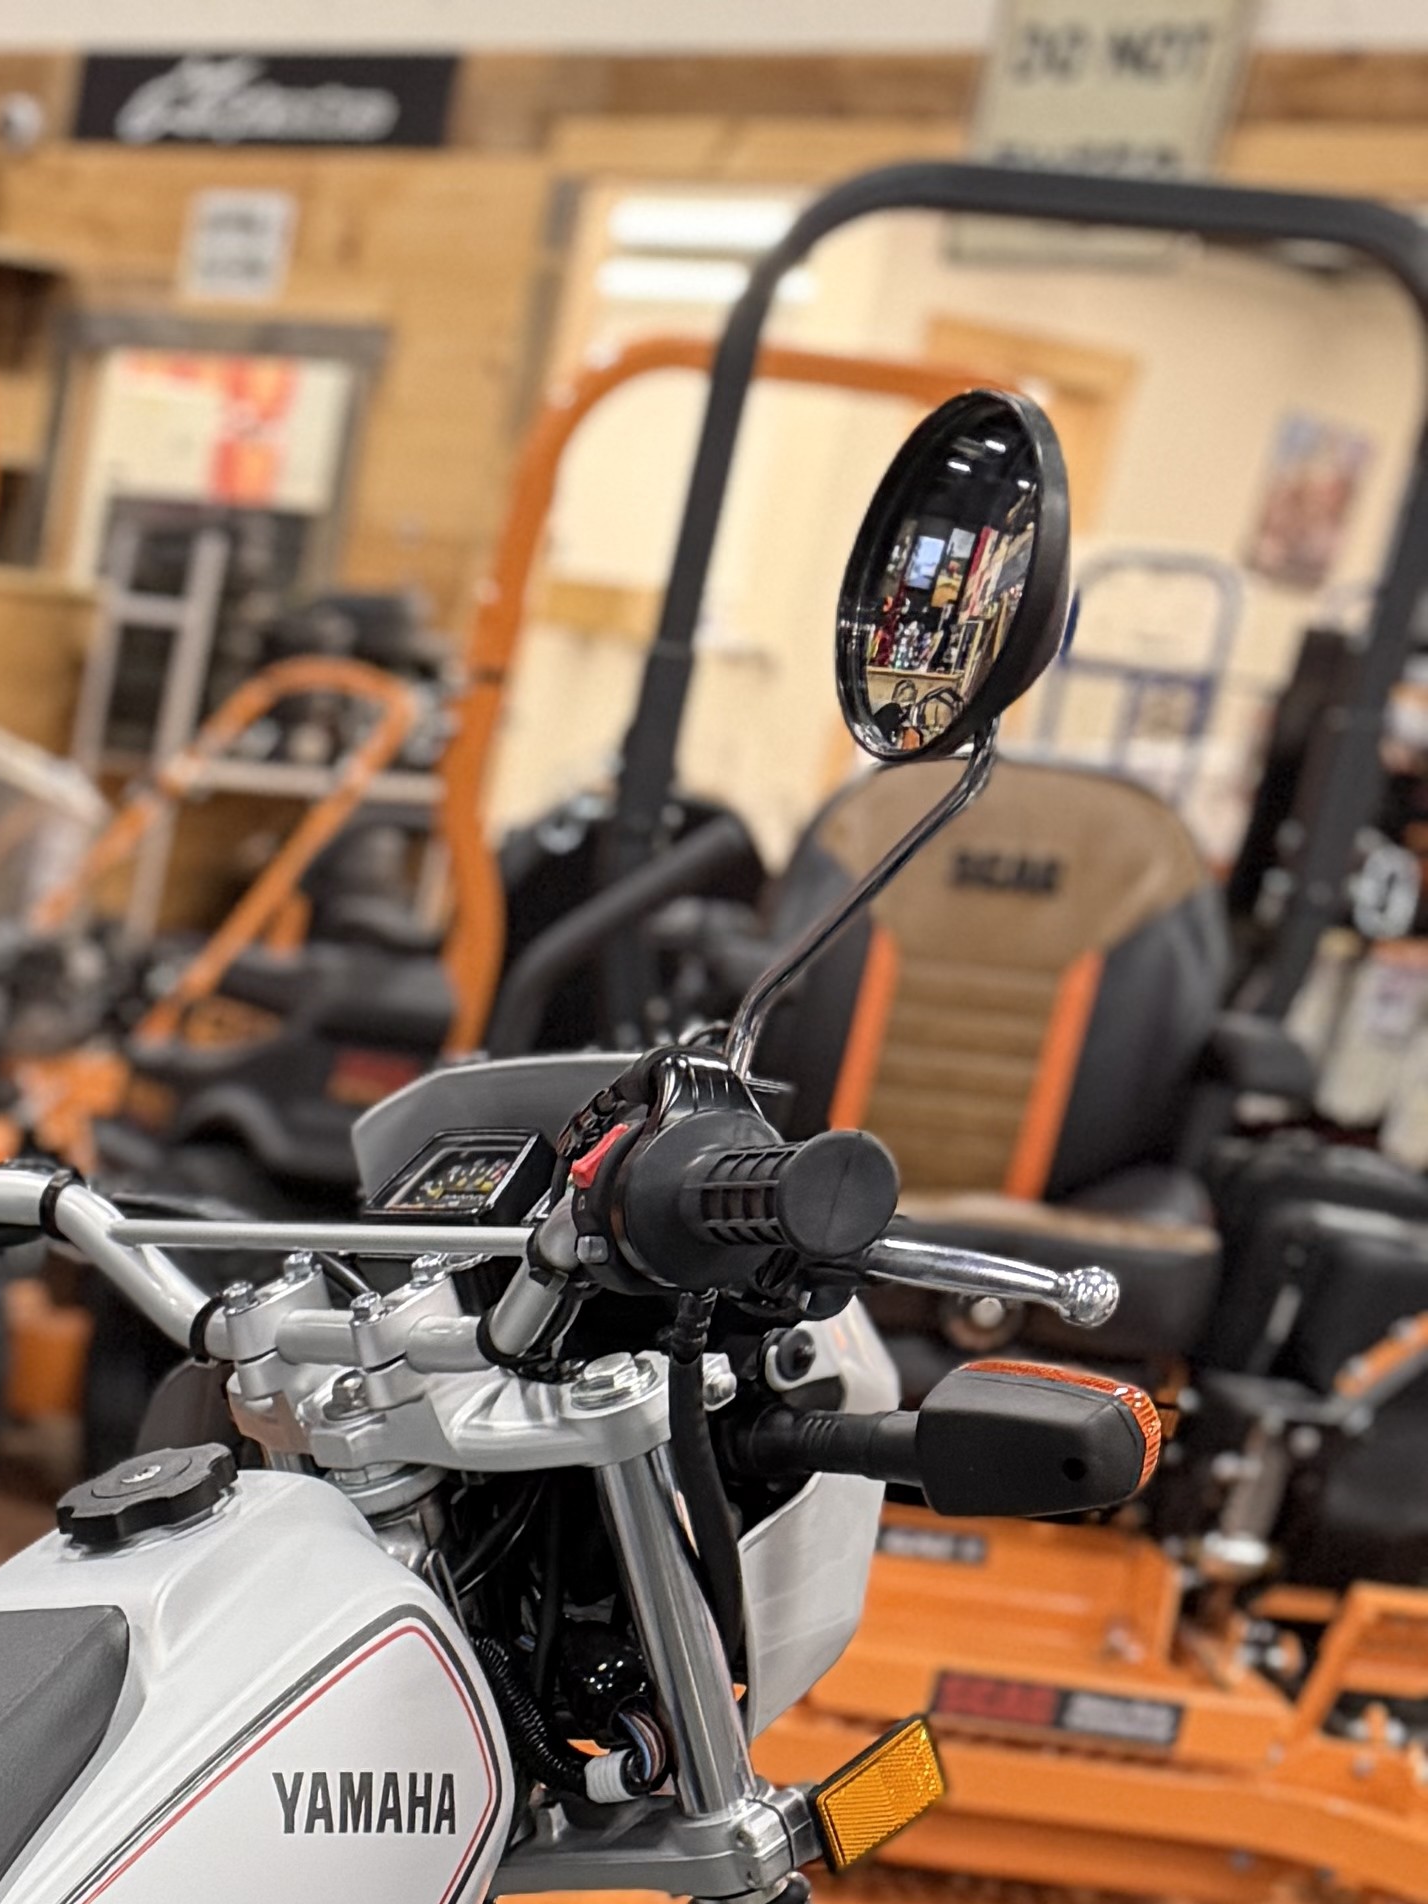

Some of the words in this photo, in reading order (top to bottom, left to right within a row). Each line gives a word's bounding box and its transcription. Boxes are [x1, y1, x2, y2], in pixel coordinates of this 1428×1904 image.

[1108, 24, 1212, 80] NOT
[948, 846, 1061, 896] SCAG
[271, 1771, 457, 1835] YAMAHA
